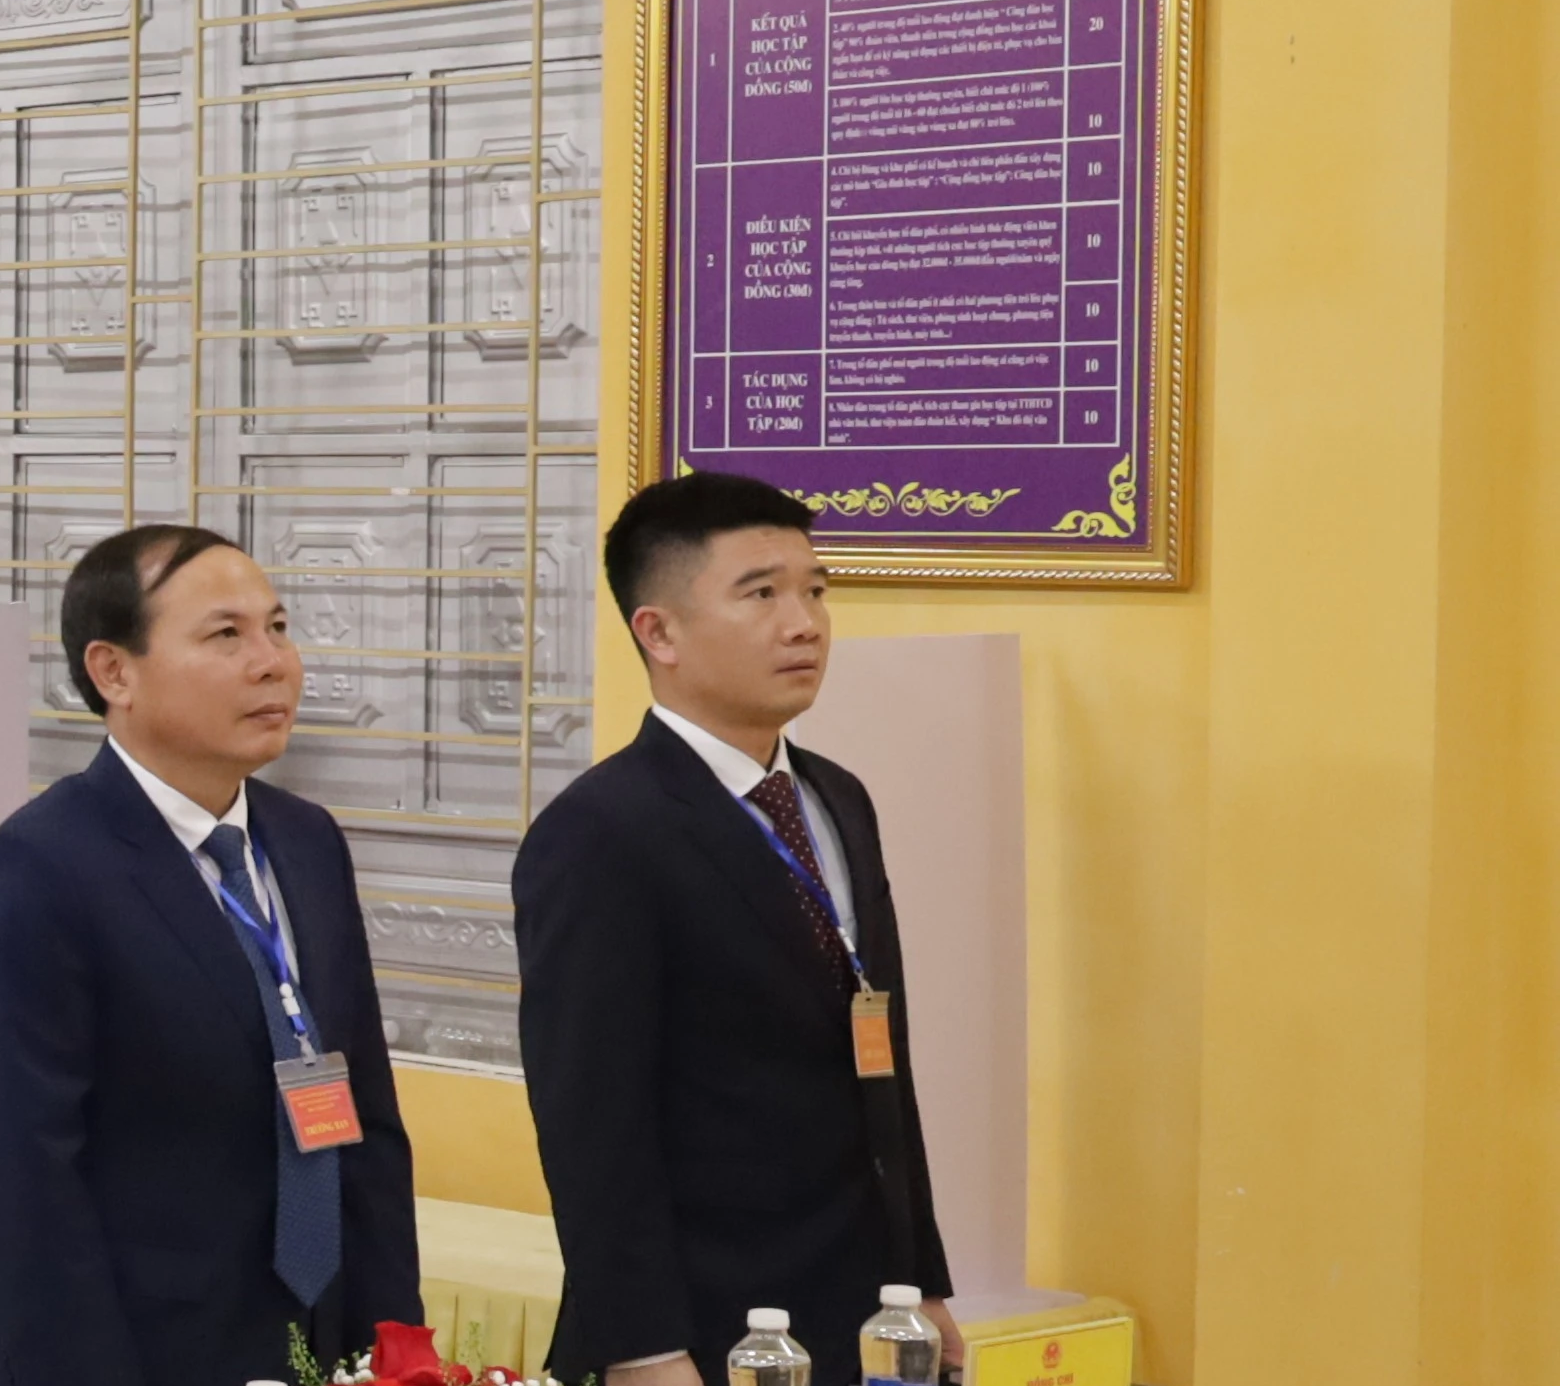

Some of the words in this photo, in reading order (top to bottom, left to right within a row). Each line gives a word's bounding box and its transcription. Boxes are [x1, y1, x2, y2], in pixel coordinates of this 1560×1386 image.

[751, 12, 777, 32] KẾT
[779, 10, 808, 32] QUẢ
[1089, 17, 1105, 32] 20
[751, 38, 780, 56] HỌC
[782, 33, 808, 53] TẬP
[745, 56, 771, 76] CỦA
[774, 55, 812, 75] CỘNG
[744, 76, 781, 97] ĐỒNG
[1088, 114, 1102, 128] 10
[743, 371, 769, 388] TÁC
[771, 373, 808, 391] DỤNG
[746, 392, 772, 409] CỦA
[775, 395, 804, 412] HỌC
[748, 414, 772, 433] TẬP
